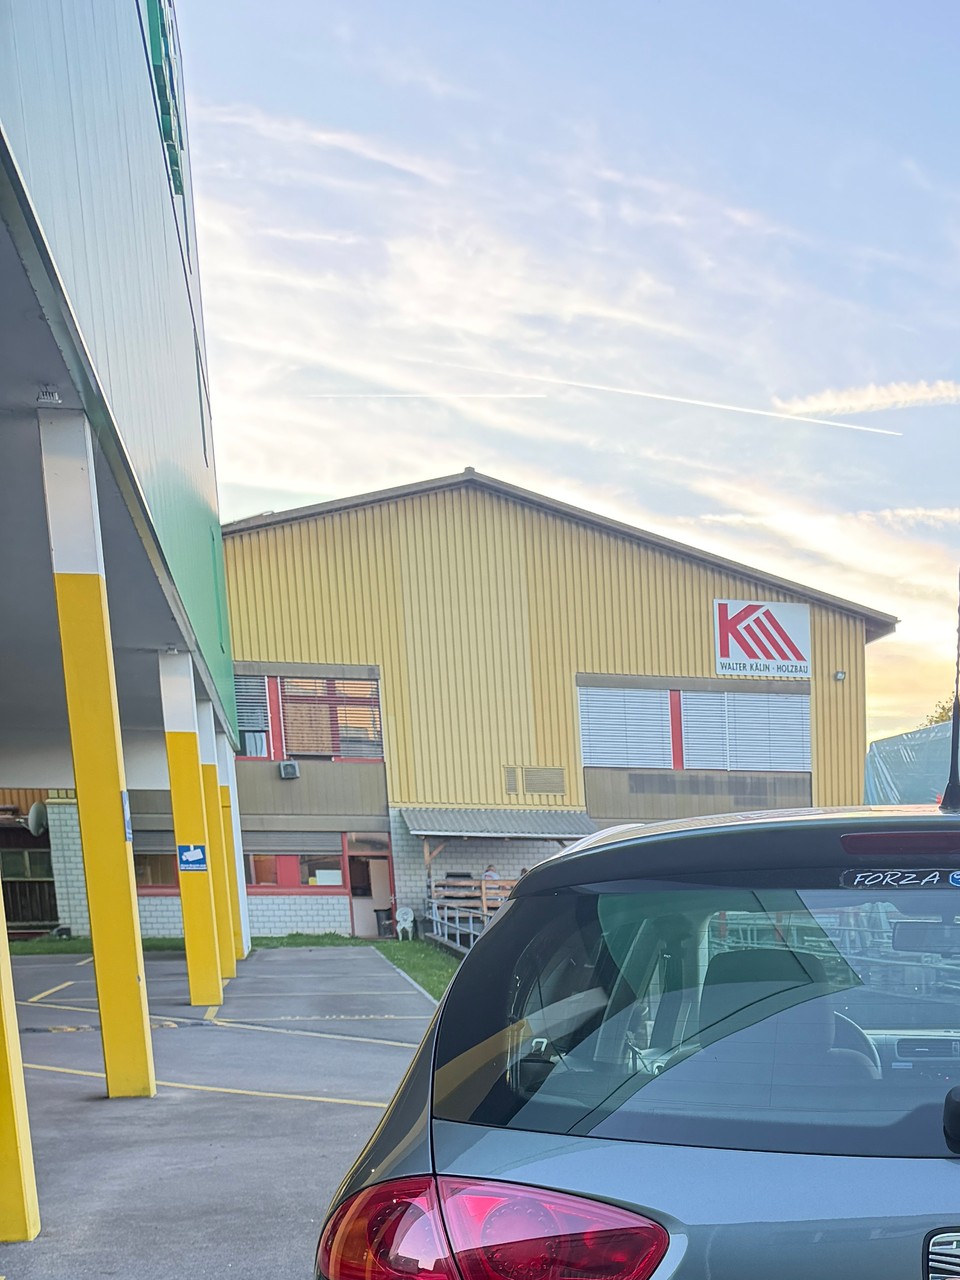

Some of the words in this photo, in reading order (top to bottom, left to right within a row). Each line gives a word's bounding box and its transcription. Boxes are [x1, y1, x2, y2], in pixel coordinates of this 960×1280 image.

[720, 662, 747, 672] WALTER
[750, 662, 770, 673] KÄLIN
[776, 664, 808, 674] HOLZBAU
[854, 872, 941, 886] FORZA
